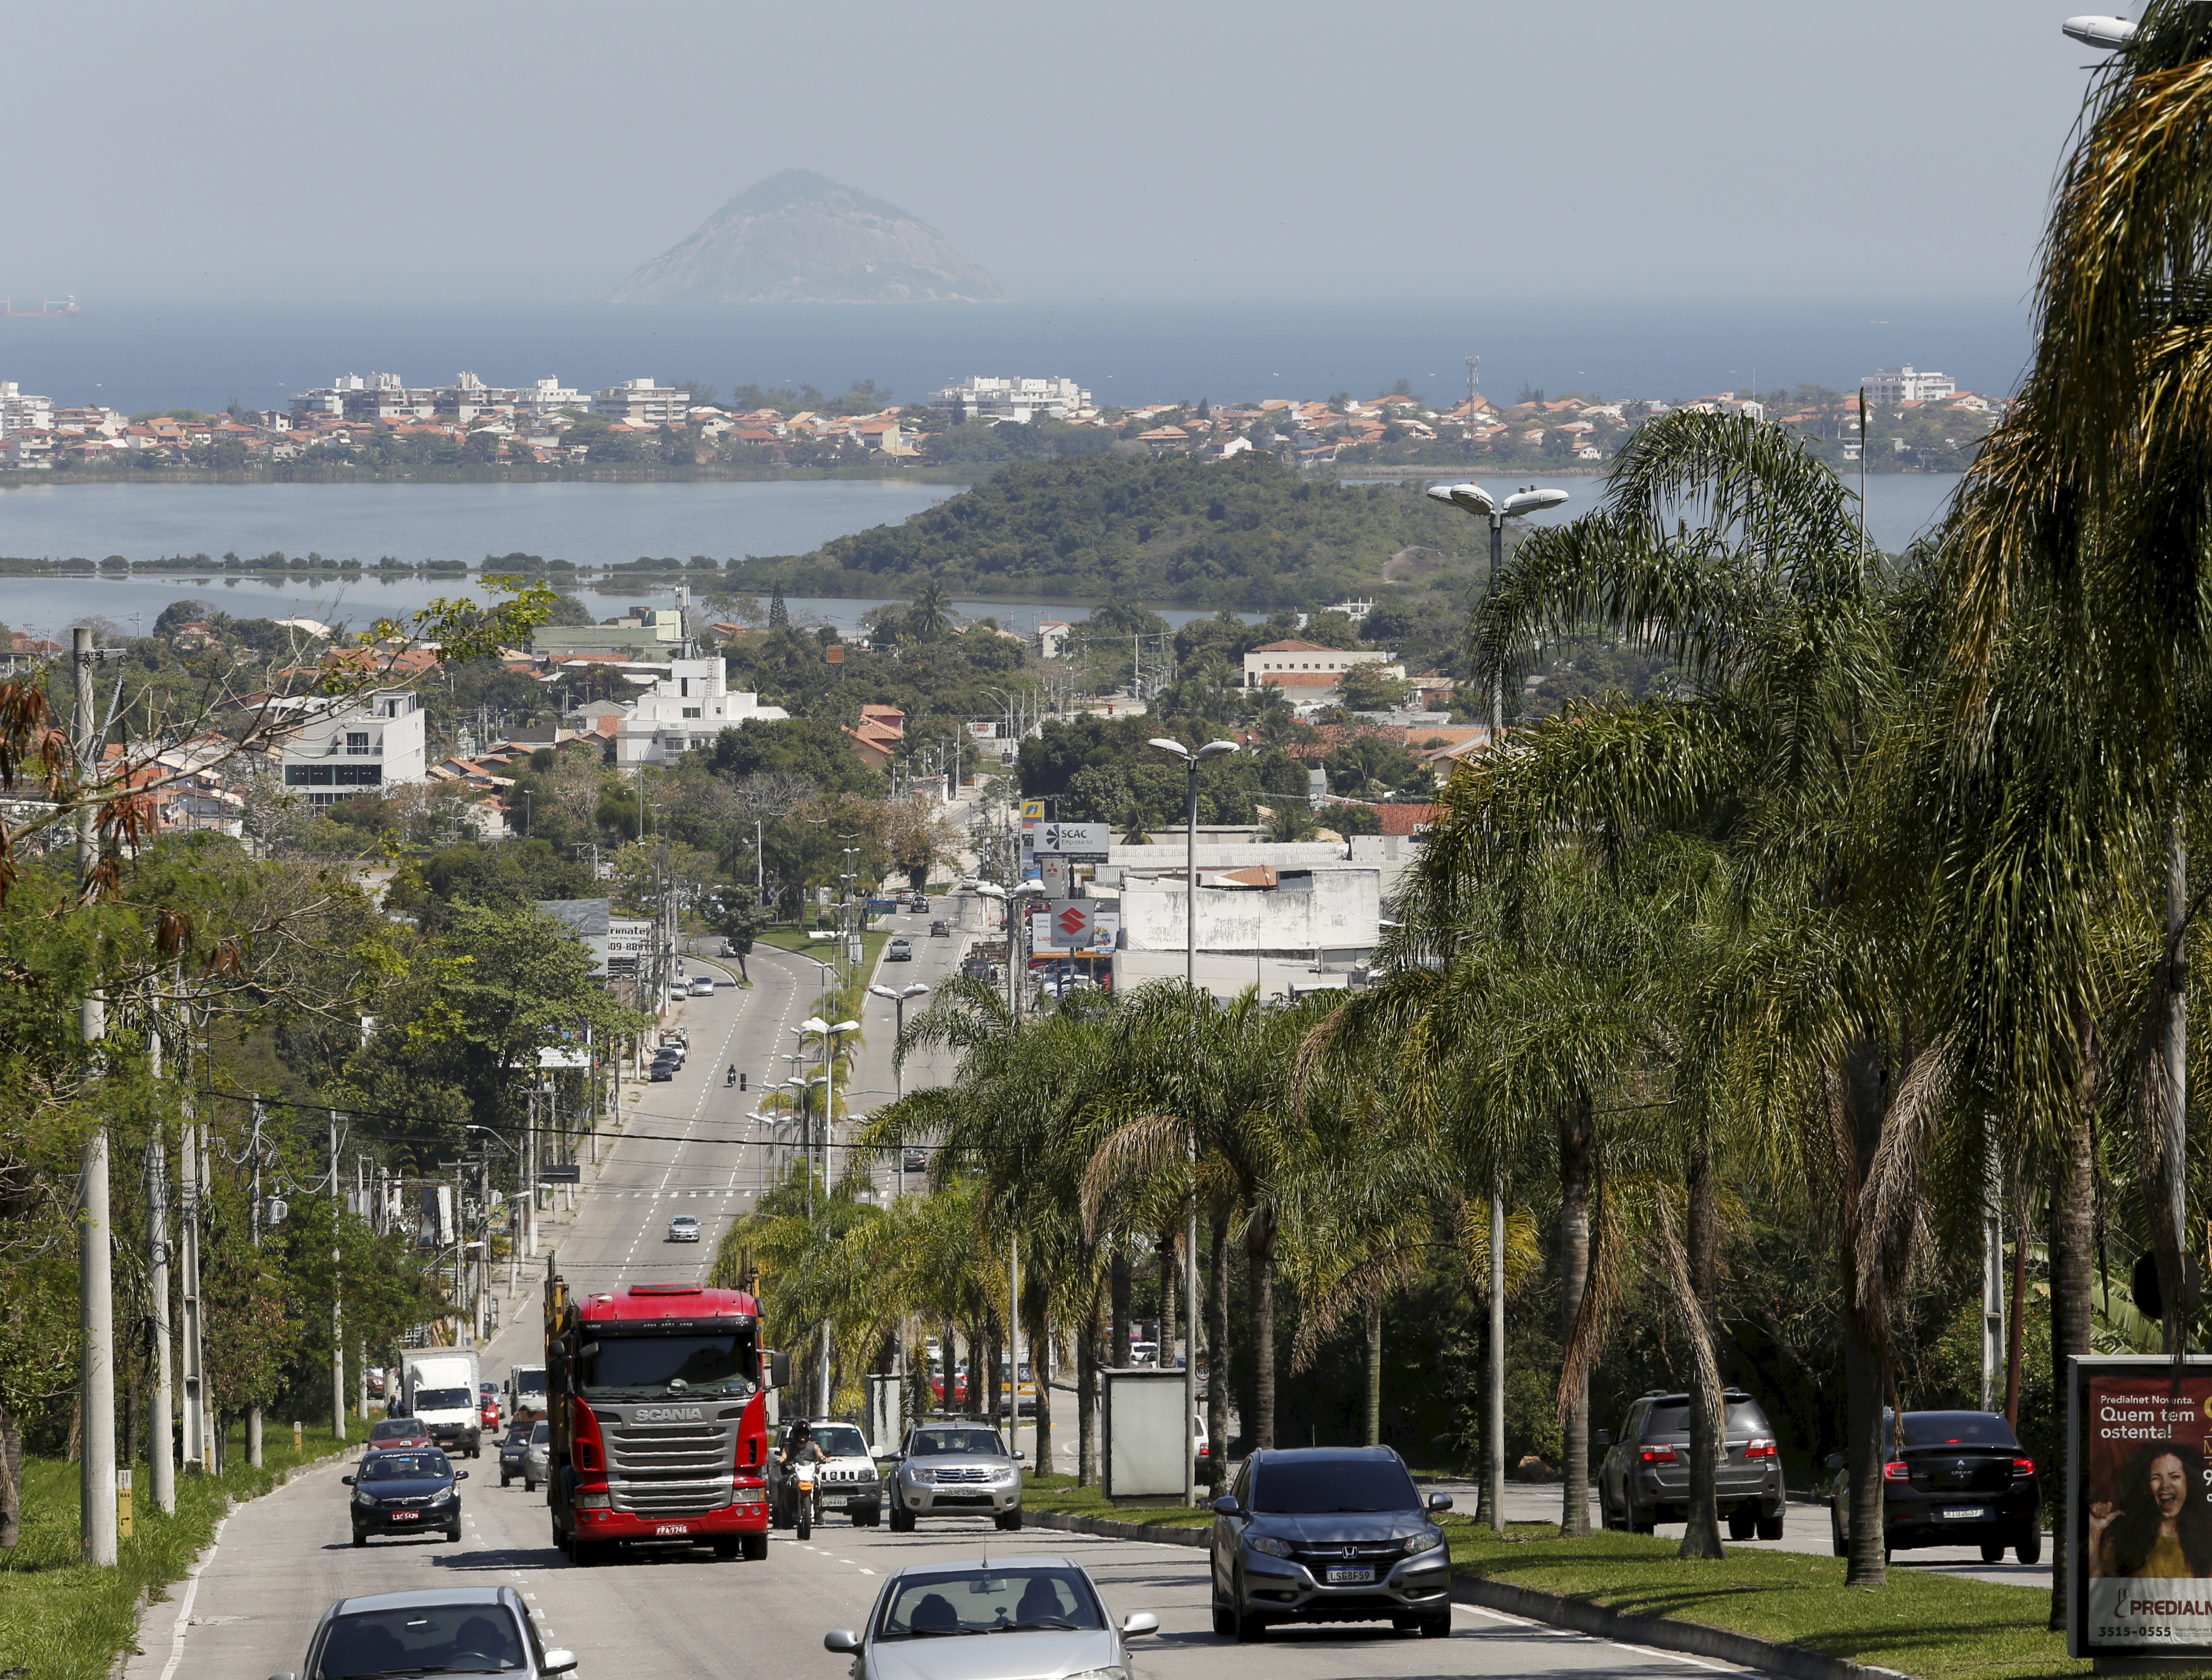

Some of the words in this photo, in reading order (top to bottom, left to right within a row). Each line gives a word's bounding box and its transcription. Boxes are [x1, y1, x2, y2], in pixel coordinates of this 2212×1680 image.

[1061, 829, 1087, 838] SCAC
[2101, 1395, 2149, 1404] Predialnet
[2152, 1396, 2195, 1404] Novnta.
[635, 1408, 703, 1421] SCANIA
[2100, 1406, 2155, 1422] Quem
[2160, 1409, 2195, 1422] tem
[2101, 1424, 2172, 1439] ostenta!
[1331, 1571, 1370, 1581] LSG8F59
[2099, 1626, 2171, 1637] 3515-0555
